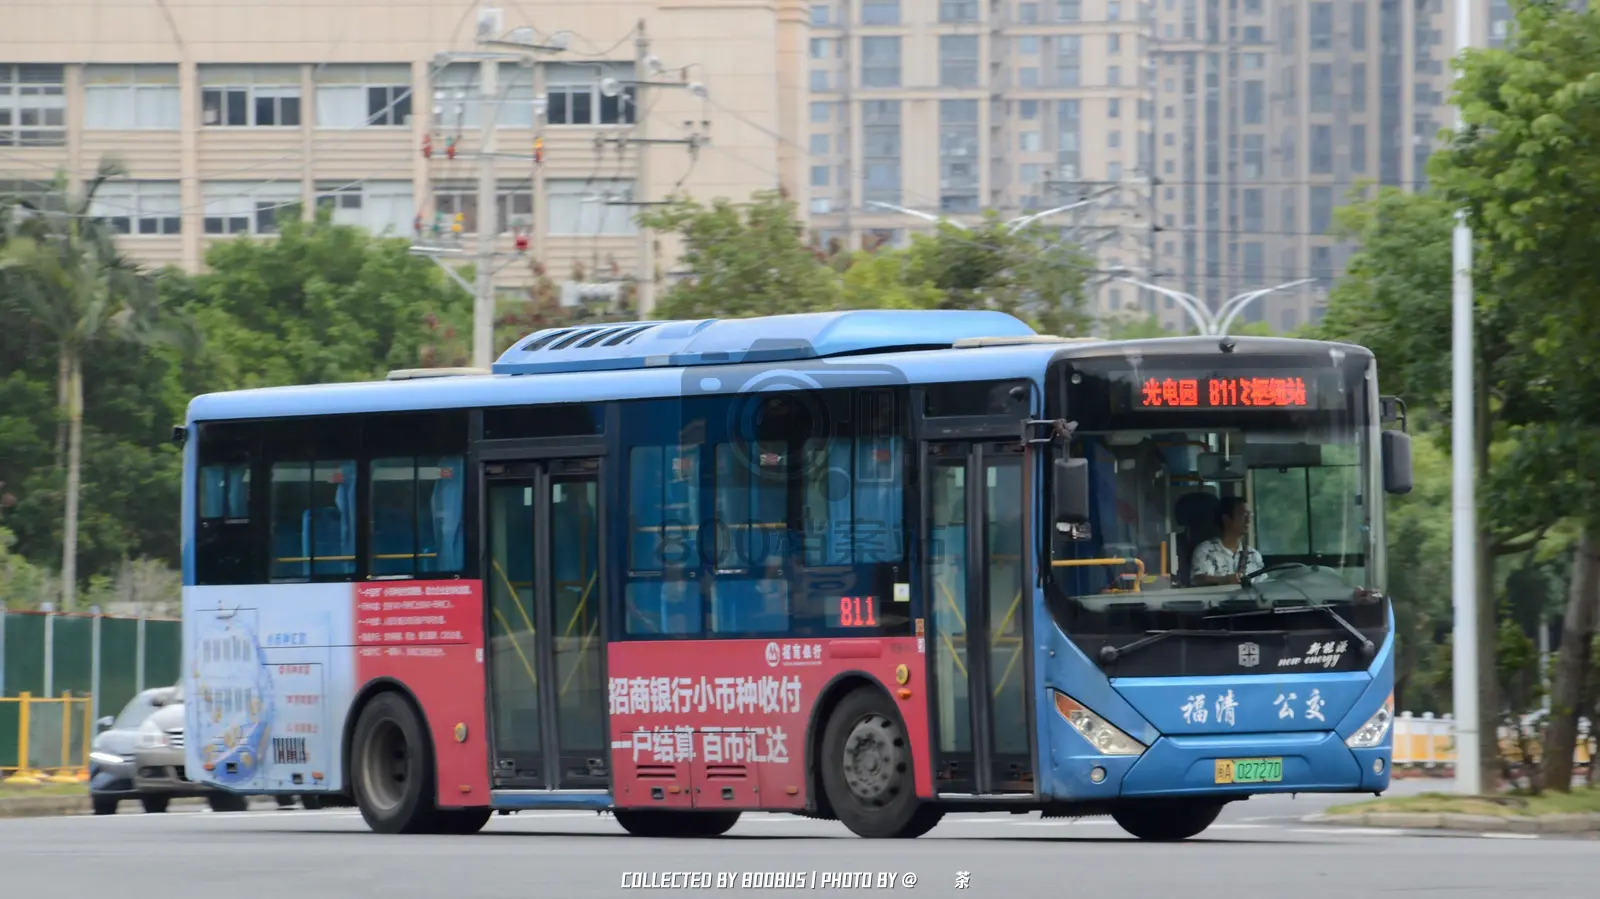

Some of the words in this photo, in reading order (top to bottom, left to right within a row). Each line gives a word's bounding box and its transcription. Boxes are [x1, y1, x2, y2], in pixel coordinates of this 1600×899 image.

[1142, 377, 1198, 406] 光电园
[1209, 379, 1237, 406] 811
[840, 596, 876, 627] 811
[1277, 657, 1302, 667] new
[1303, 654, 1341, 669] energy
[1306, 640, 1349, 656] 新能源
[608, 675, 802, 715] 招商银行小币种收付
[1180, 689, 1239, 727] 福清
[1273, 688, 1326, 722] 公交
[611, 725, 696, 763] 一户结算
[702, 726, 789, 763] 百币汇达
